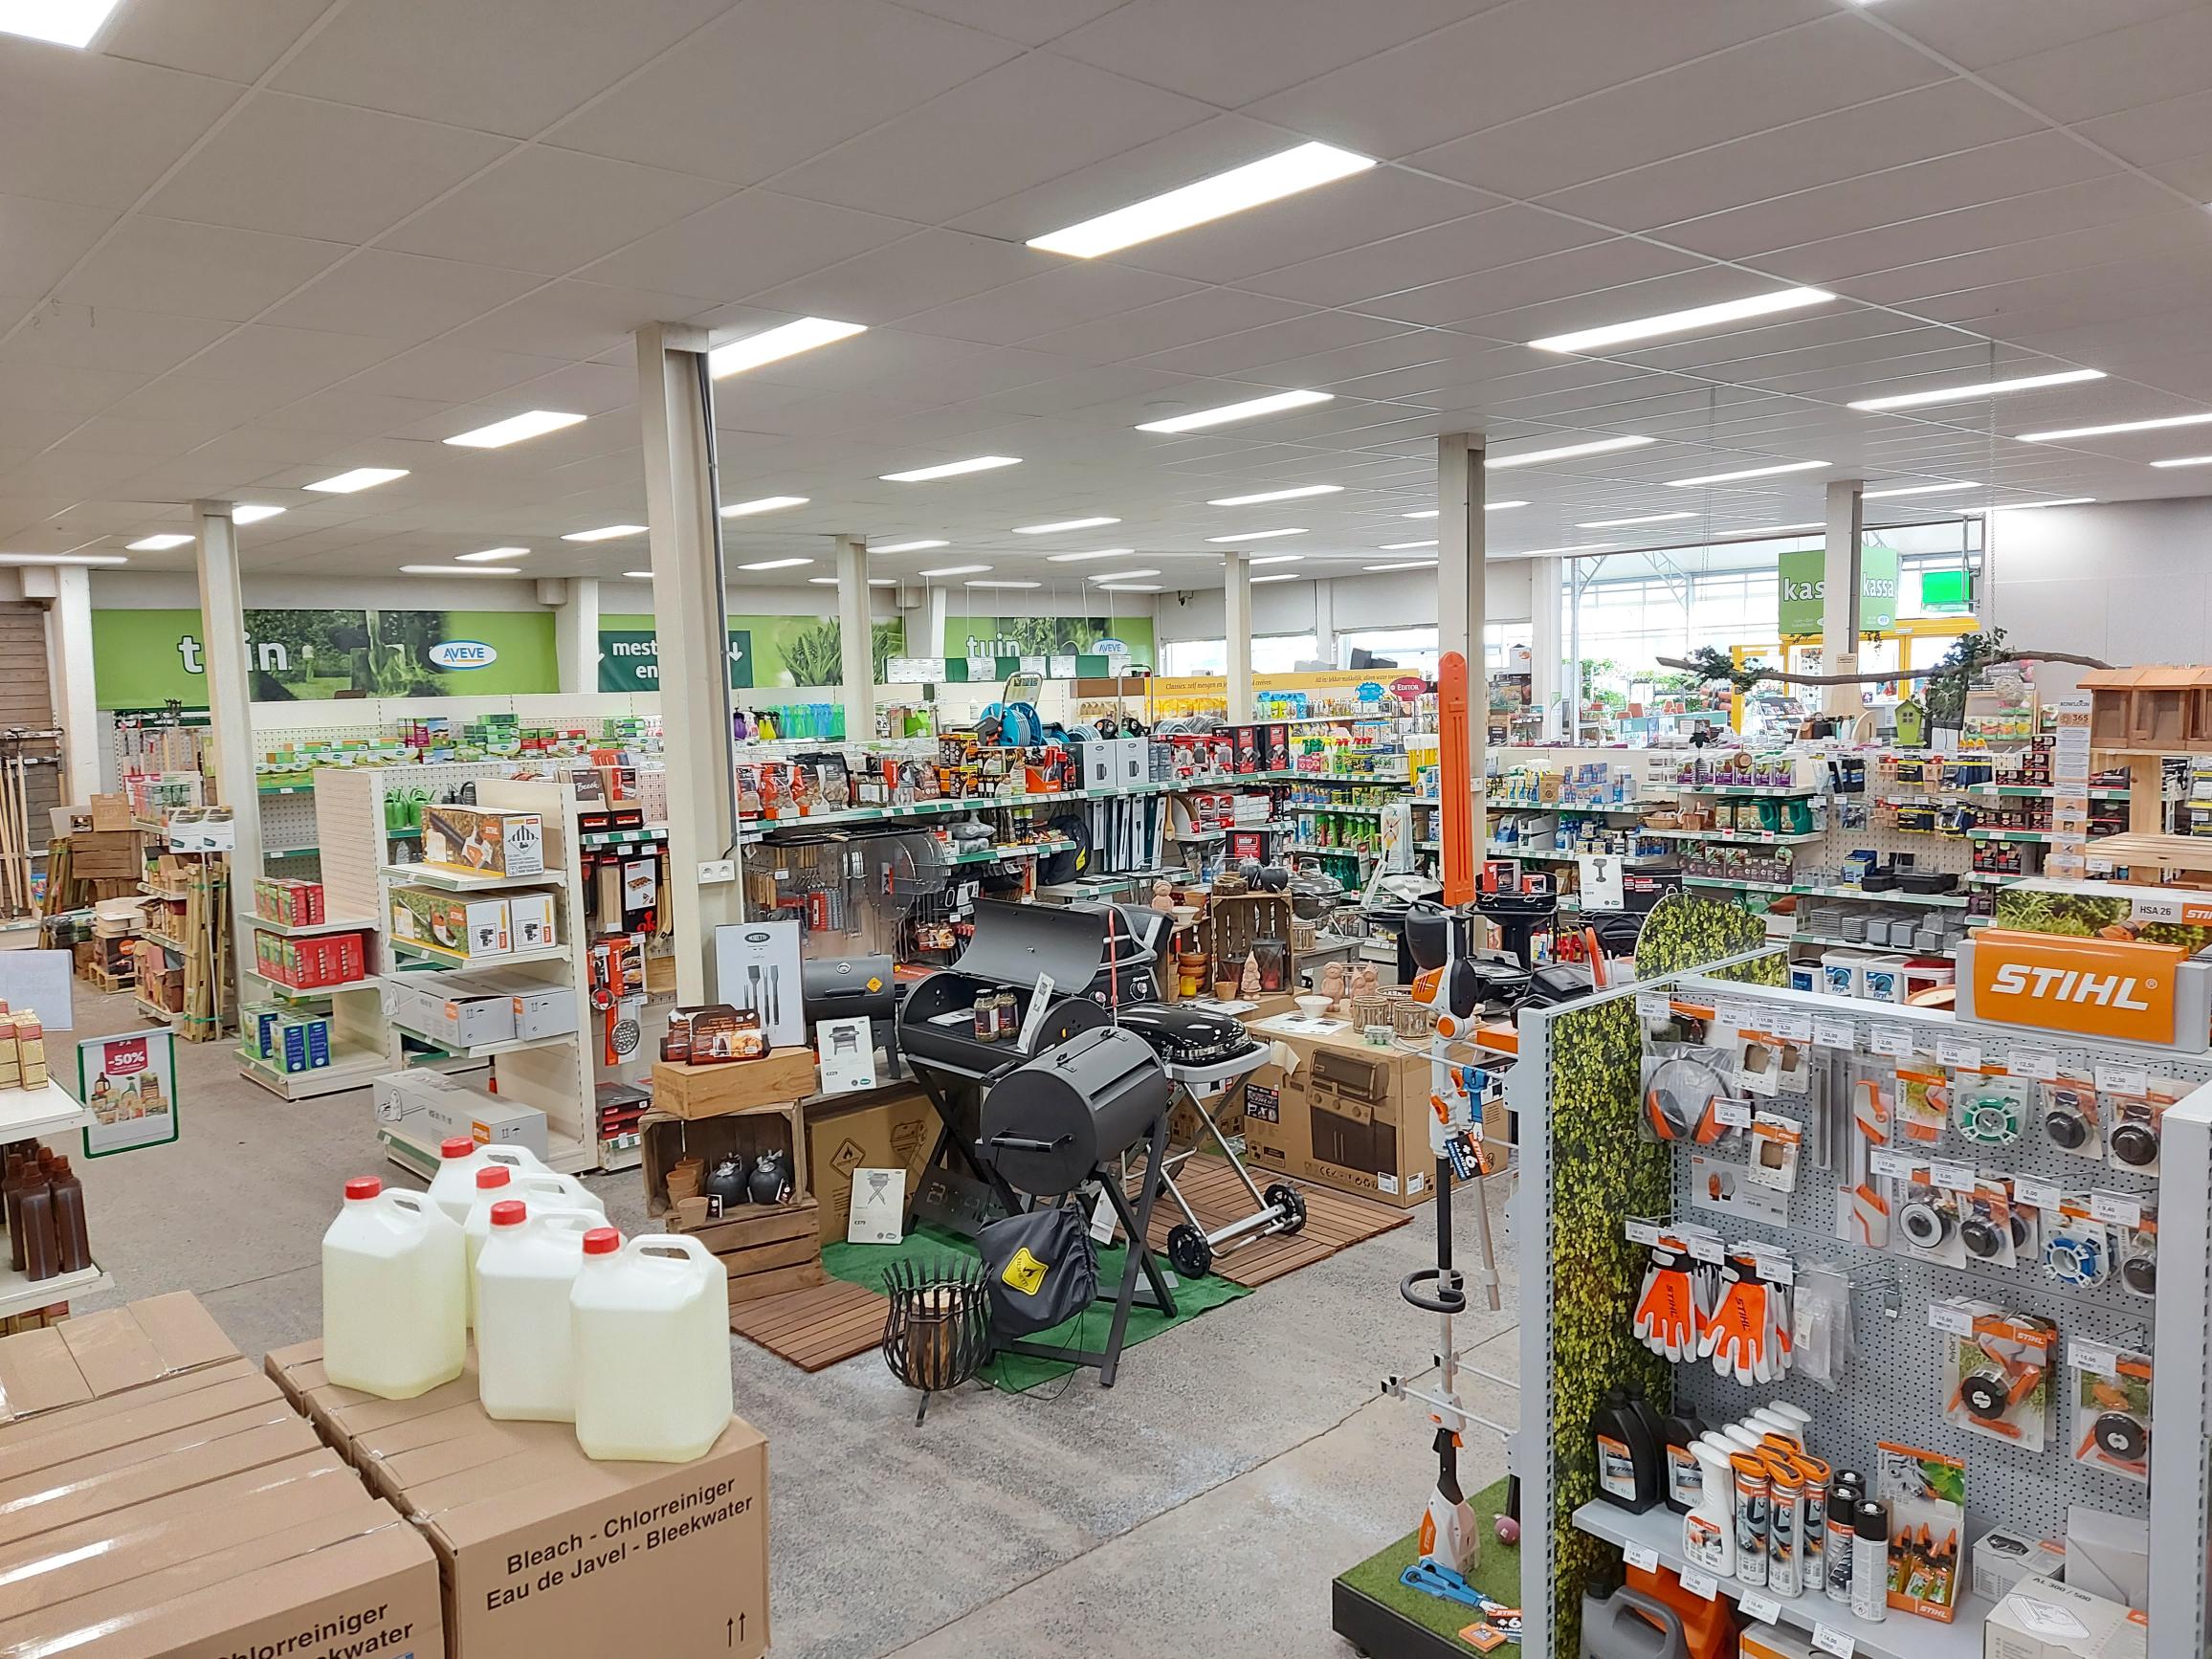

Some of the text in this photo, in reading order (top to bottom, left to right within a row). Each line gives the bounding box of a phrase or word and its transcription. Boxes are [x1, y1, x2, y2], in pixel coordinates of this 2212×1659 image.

[1782, 577, 1825, 601] kas
[1862, 573, 1894, 598] kassa
[177, 630, 288, 673] tin
[444, 648, 484, 662] AVEVE
[612, 639, 658, 656] mest
[966, 632, 1021, 657] tuin
[1099, 644, 1121, 653] AVEVE
[2139, 905, 2171, 917] HSA 26
[2186, 909, 2212, 920] STI
[1990, 963, 2150, 1011] STIHL
[108, 1051, 145, 1066] -50%
[1666, 1284, 1678, 1318] STIHL
[1735, 1296, 1751, 1332] STIHL
[2017, 1332, 2045, 1345] STIHL
[507, 1534, 583, 1575] Bleach
[604, 1478, 736, 1538] Chlorreiniger
[486, 1583, 529, 1610] Eau
[537, 1570, 564, 1591] de
[570, 1542, 627, 1580] Javel
[646, 1496, 753, 1550] Bleekwater
[2032, 1577, 2046, 1585] AL
[2048, 1582, 2067, 1593] 300
[2073, 1591, 2092, 1603] 500
[1919, 1604, 1948, 1619] STIHL
[218, 1604, 388, 1659] hlorreiniger
[316, 1623, 414, 1659] kwater
